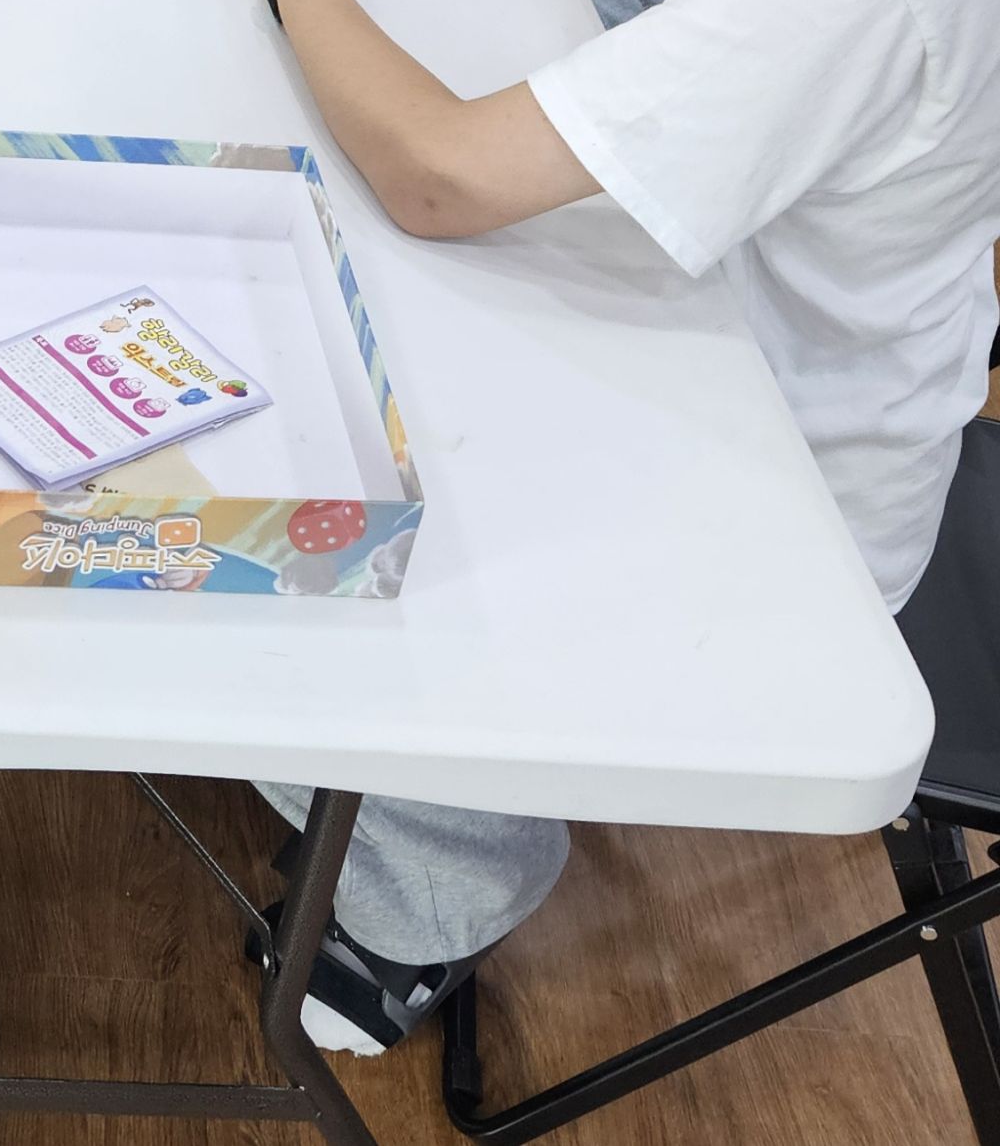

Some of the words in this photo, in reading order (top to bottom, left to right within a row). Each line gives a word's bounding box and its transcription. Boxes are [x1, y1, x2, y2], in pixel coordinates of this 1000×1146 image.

[137, 318, 218, 383] 할리갈리
[43, 522, 75, 539] Dice
[79, 516, 154, 539] Jumping
